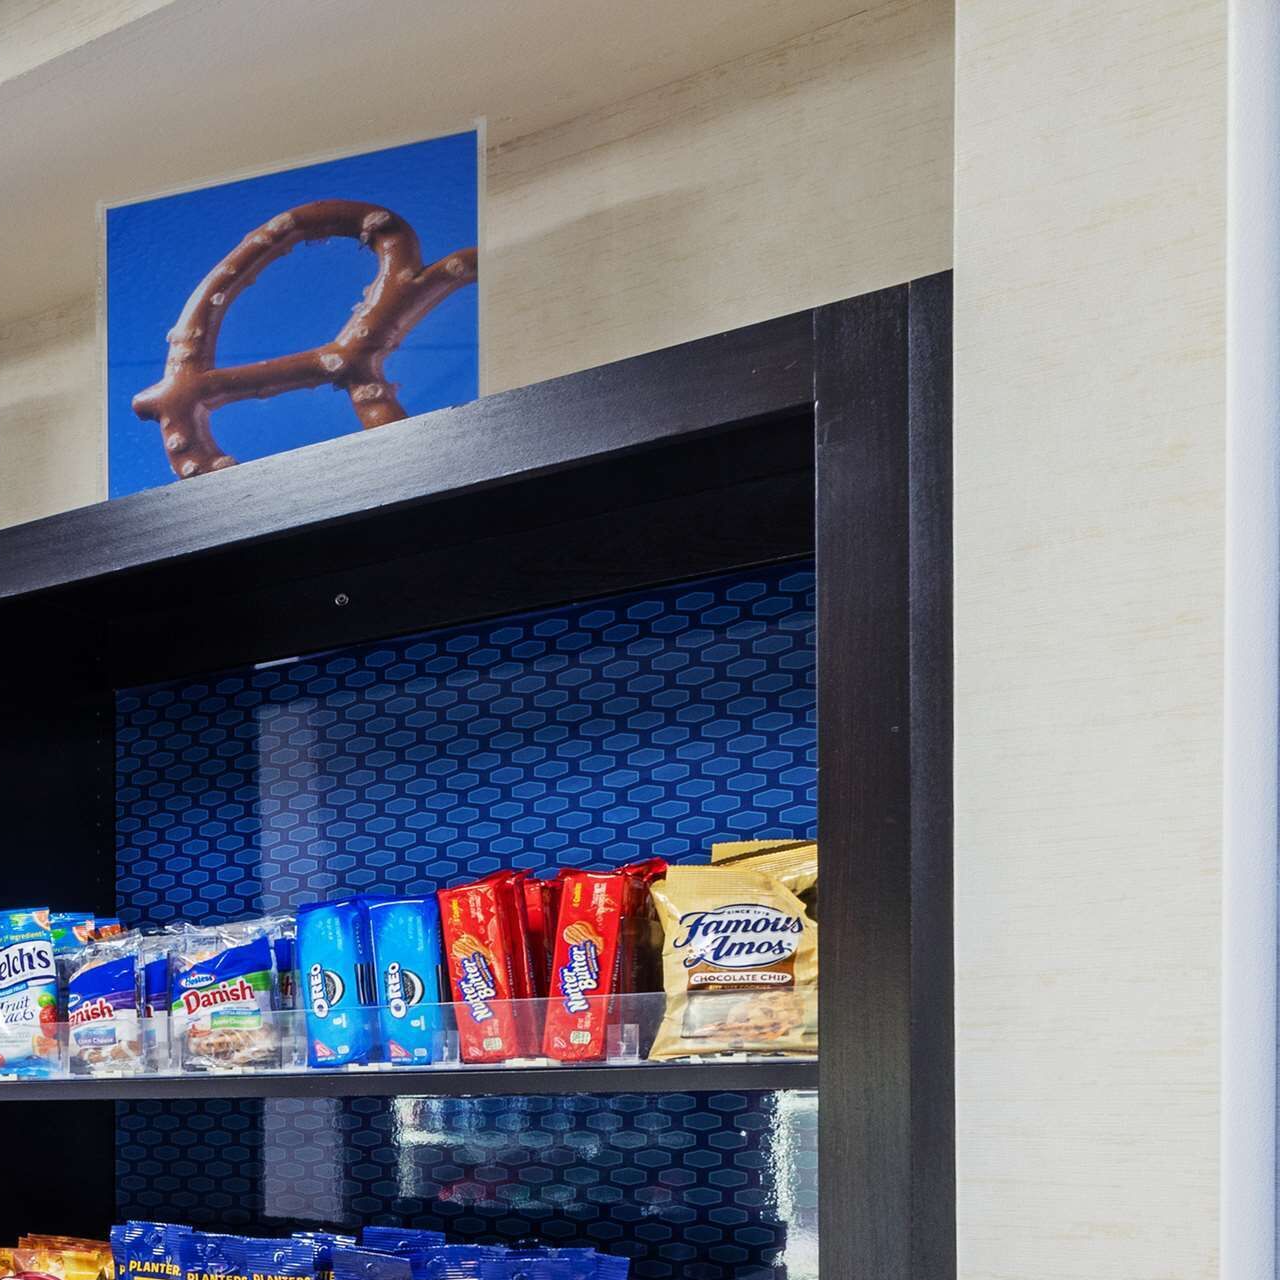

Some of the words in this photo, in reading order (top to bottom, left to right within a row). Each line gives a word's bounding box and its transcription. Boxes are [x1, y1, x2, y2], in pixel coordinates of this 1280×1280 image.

[673, 911, 804, 948] Famous
[571, 946, 598, 990] Butter
[683, 935, 786, 968] Amos
[183, 980, 255, 1015] Danish
[310, 963, 329, 1018] OREO
[387, 962, 408, 1019] OREO
[463, 959, 496, 998] Butter
[563, 967, 590, 1014] Nutter
[693, 974, 757, 983] CHOCOLATE
[760, 974, 788, 983] CHIP
[68, 999, 114, 1027] anish
[461, 980, 493, 1022] Nutter
[129, 1260, 182, 1276] PLANTER
